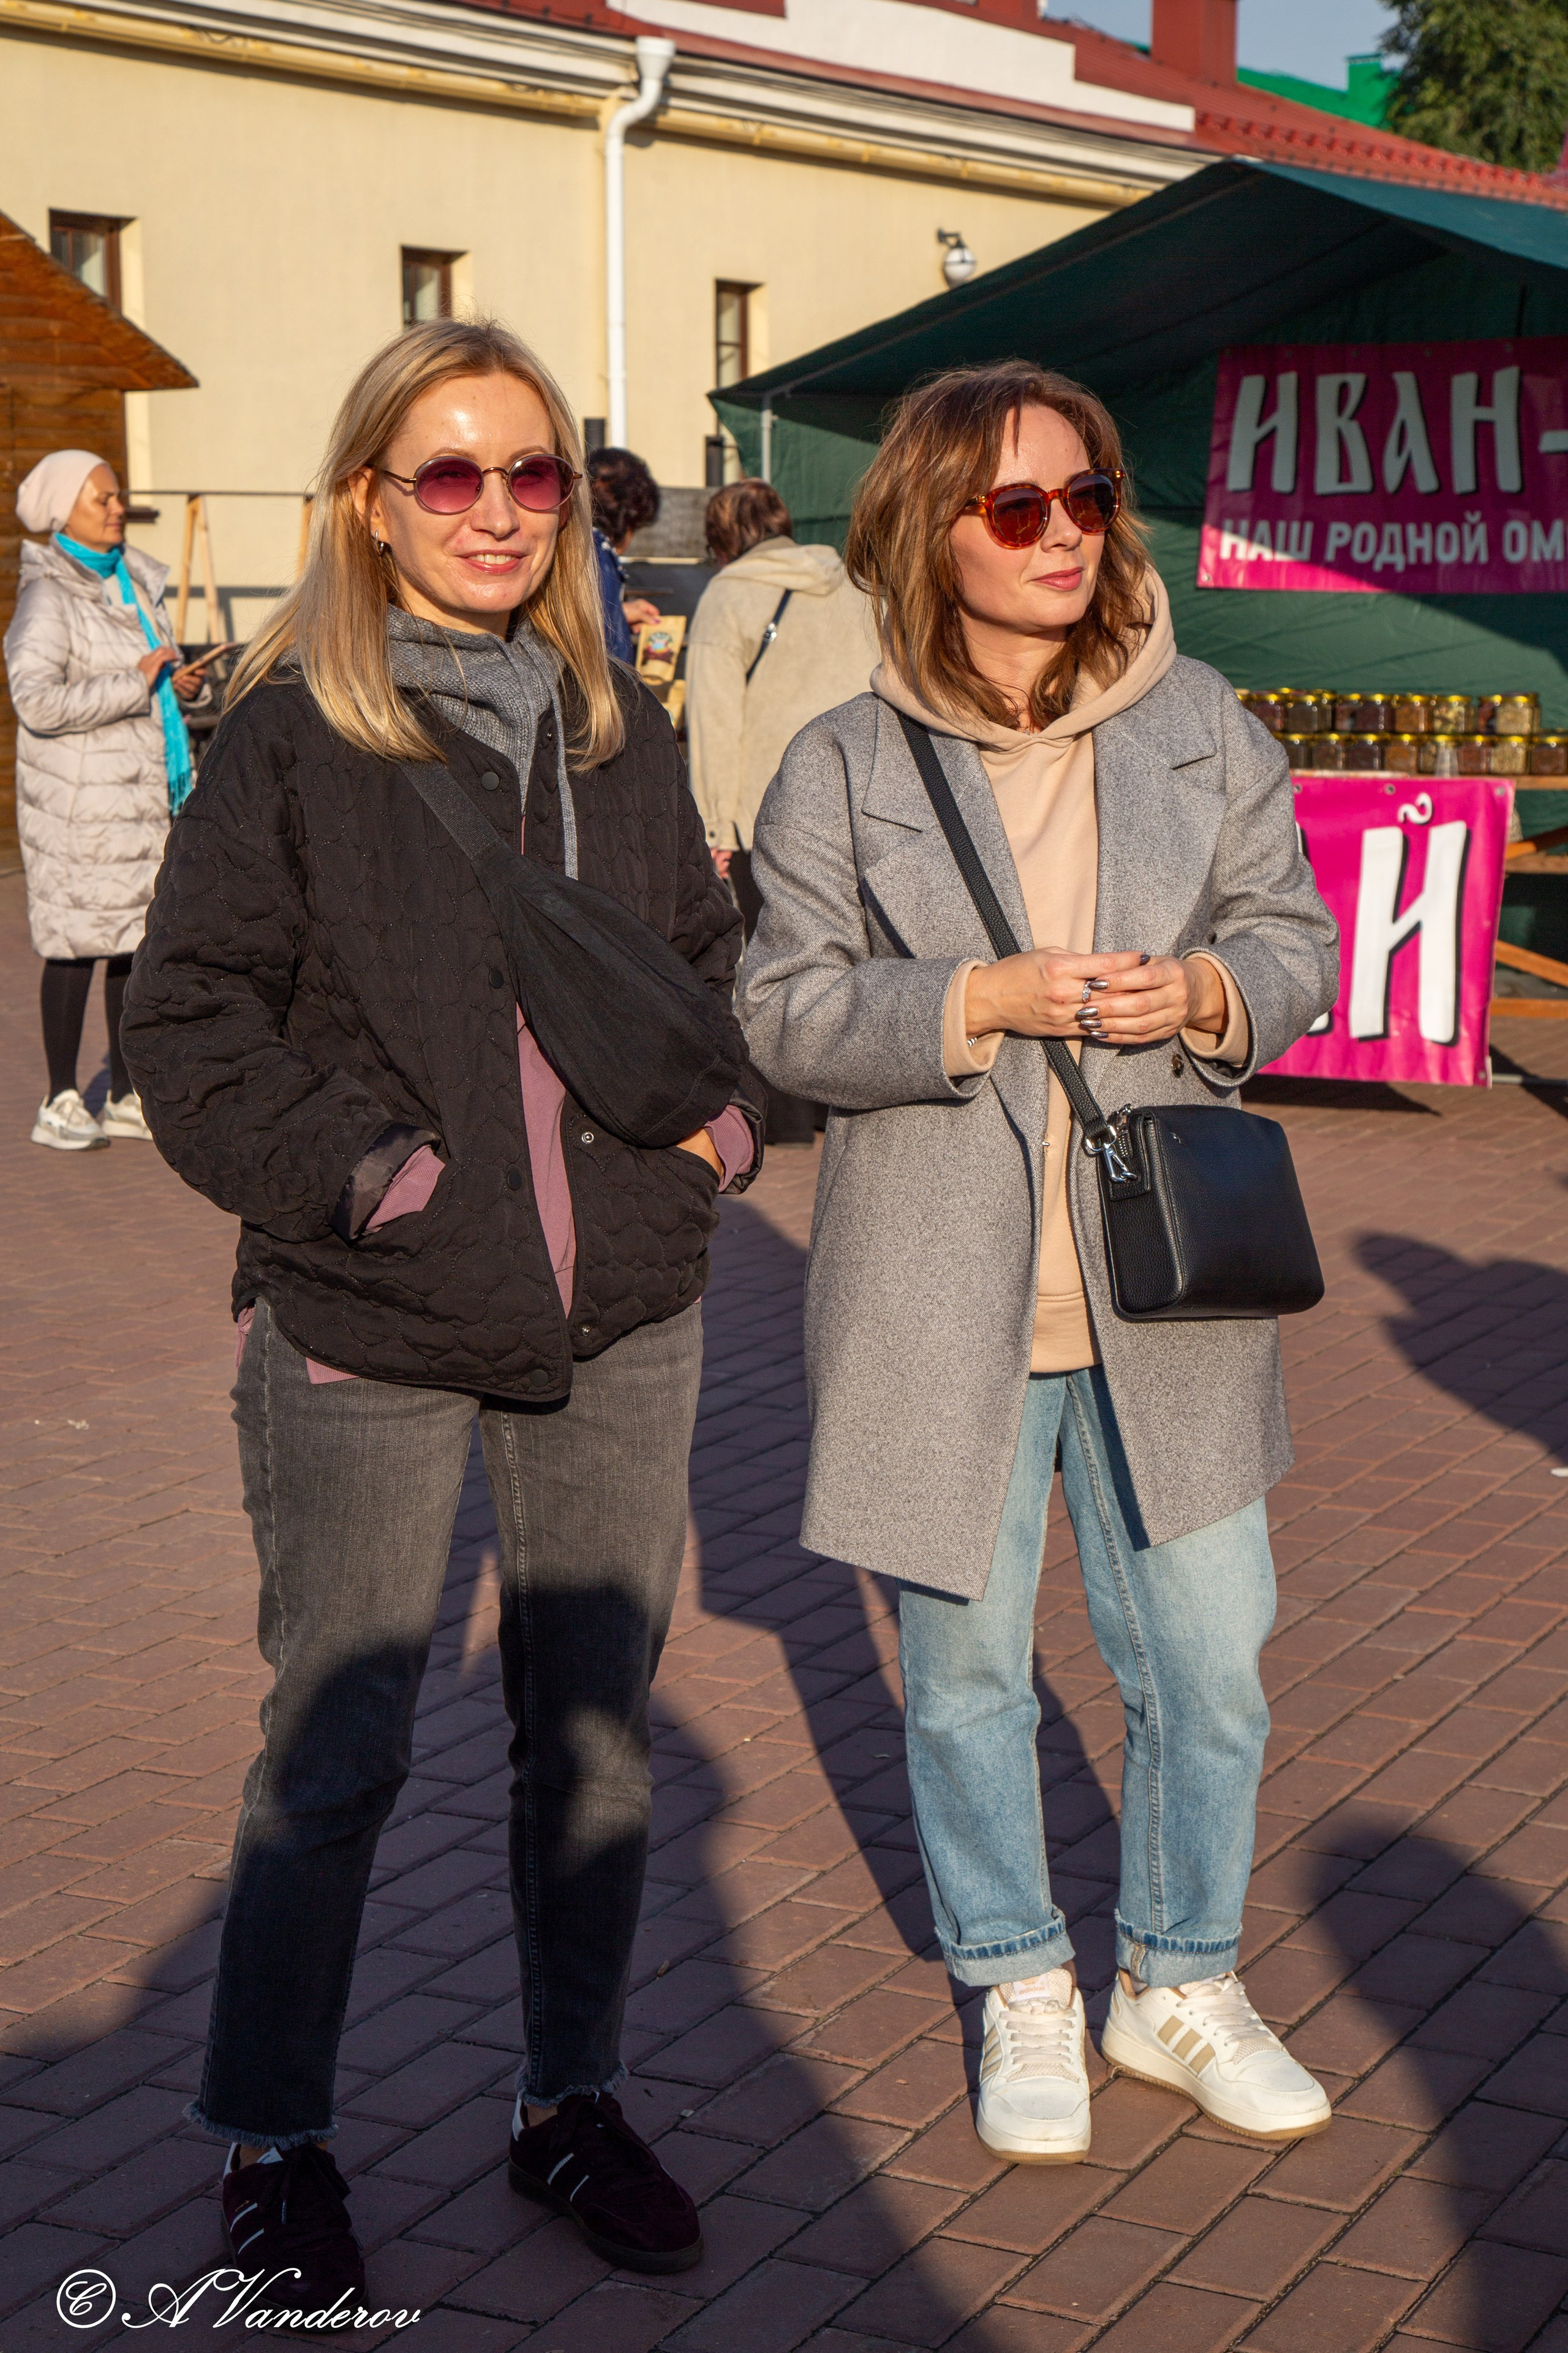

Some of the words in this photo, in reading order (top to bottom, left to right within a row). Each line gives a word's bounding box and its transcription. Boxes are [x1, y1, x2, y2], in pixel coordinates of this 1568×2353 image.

[1219, 519, 1314, 562] НАШ
[1325, 510, 1489, 573] РОДНОЙ
[1296, 793, 1467, 1043] Й
